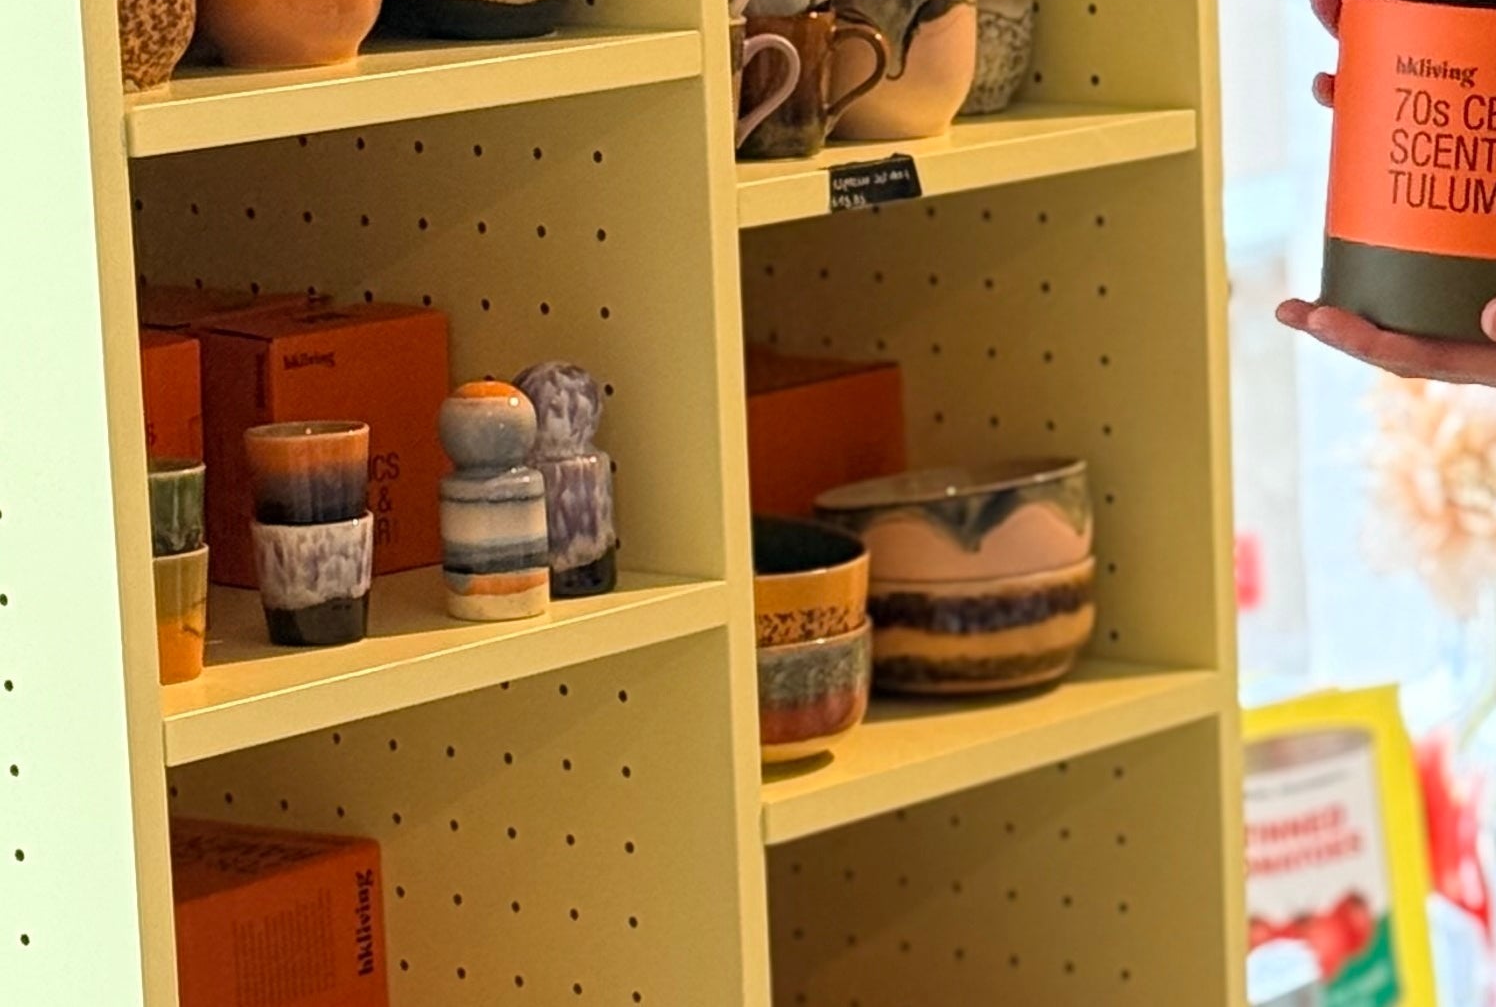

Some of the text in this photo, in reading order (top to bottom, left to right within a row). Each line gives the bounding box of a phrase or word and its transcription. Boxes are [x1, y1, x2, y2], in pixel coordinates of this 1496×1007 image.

[1396, 55, 1478, 88] hkliving
[1395, 88, 1450, 127] 70s
[355, 868, 374, 977] hkliving
